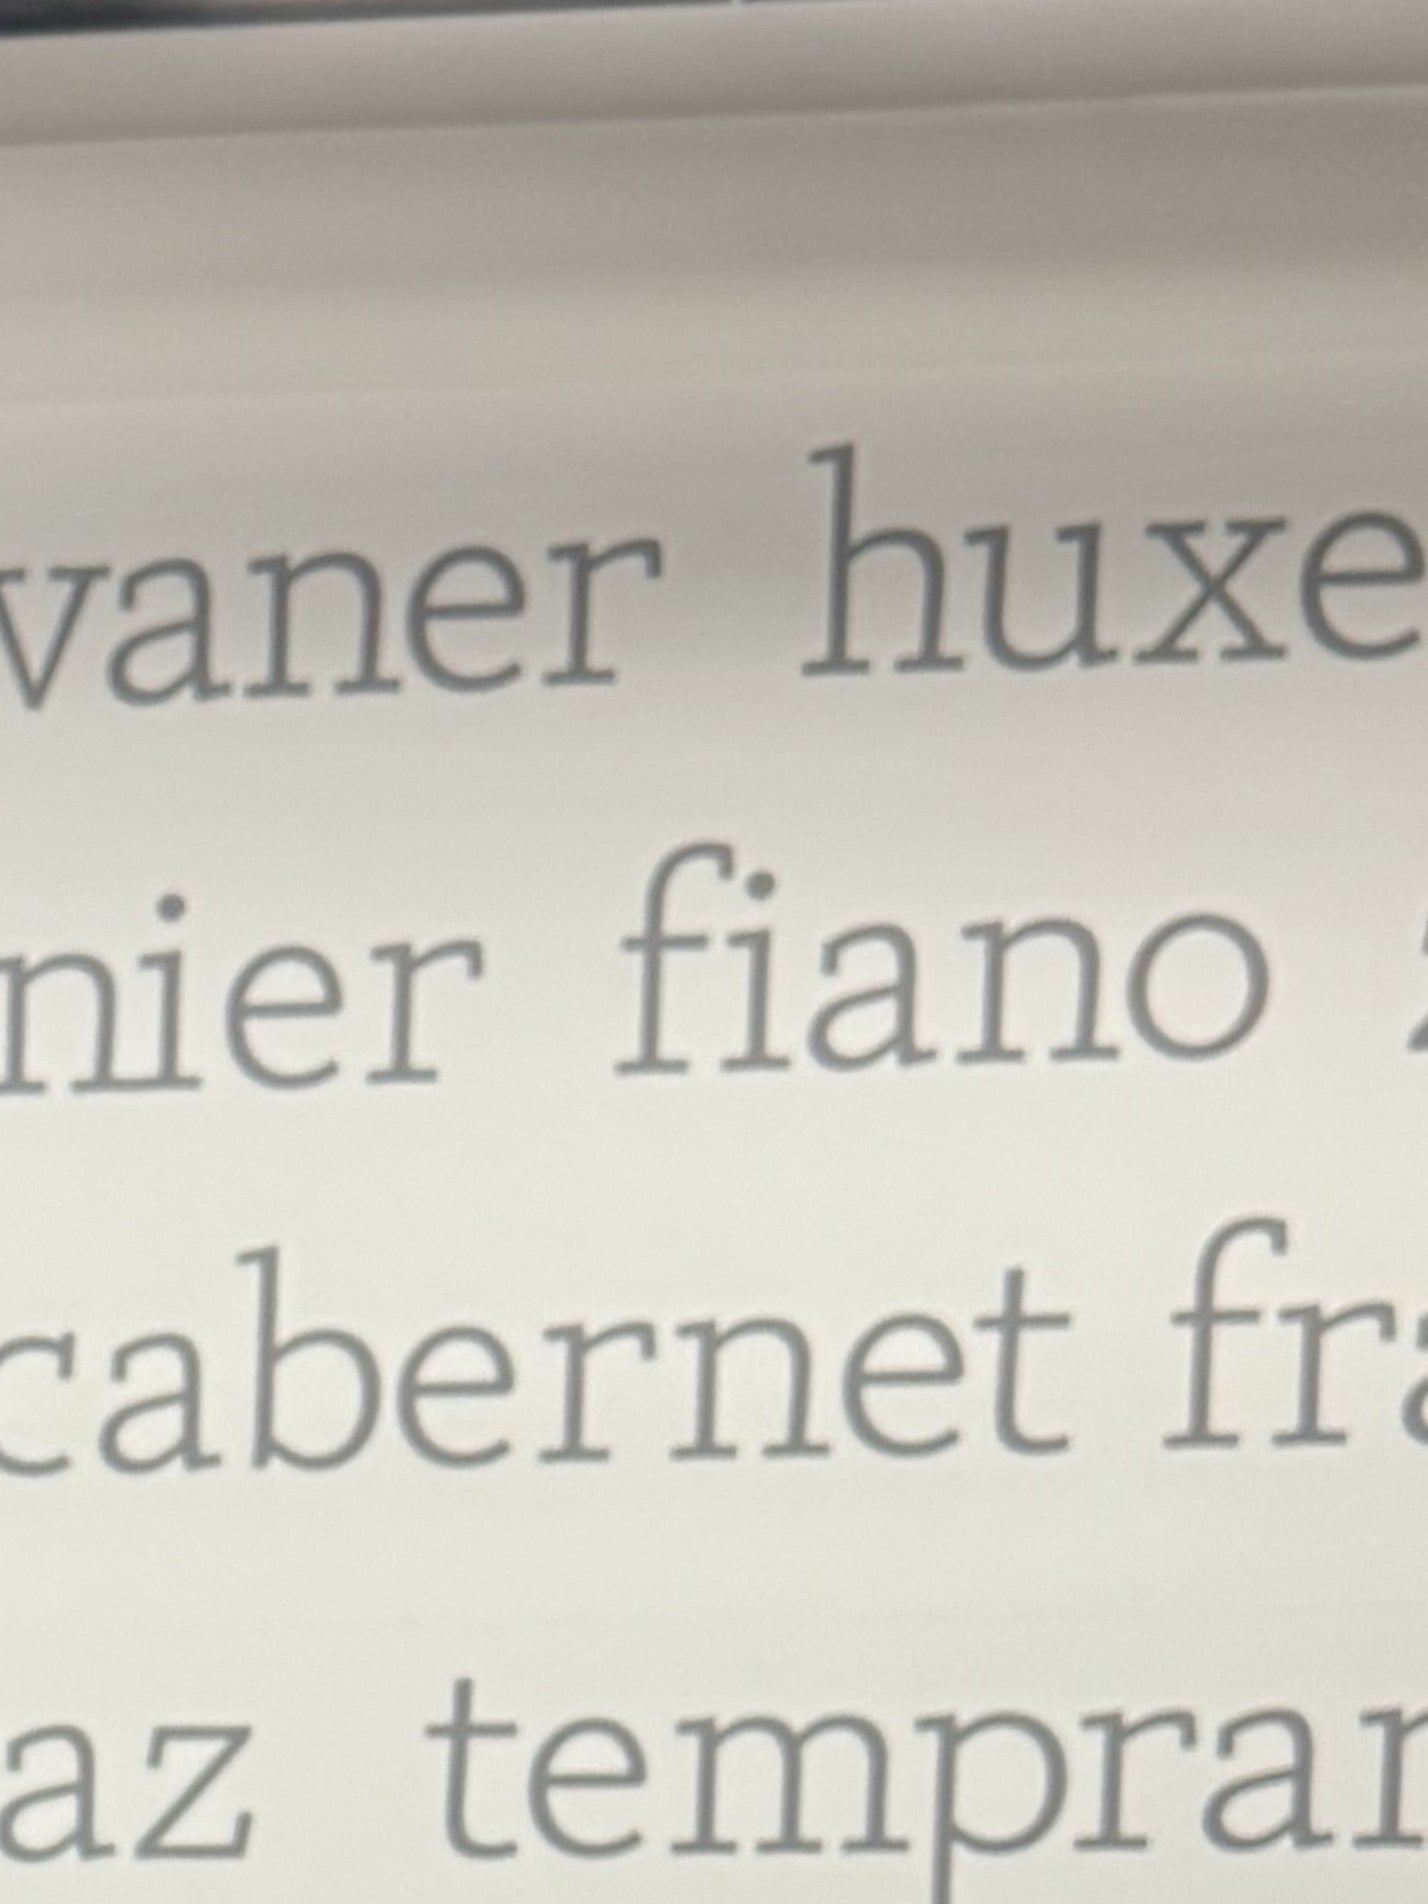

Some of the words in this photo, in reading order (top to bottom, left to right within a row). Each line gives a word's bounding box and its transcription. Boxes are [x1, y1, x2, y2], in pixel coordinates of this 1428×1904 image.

[802, 442, 1428, 676] huxe
[614, 840, 1271, 1076] fiano
[1163, 1215, 1428, 1450] fr
